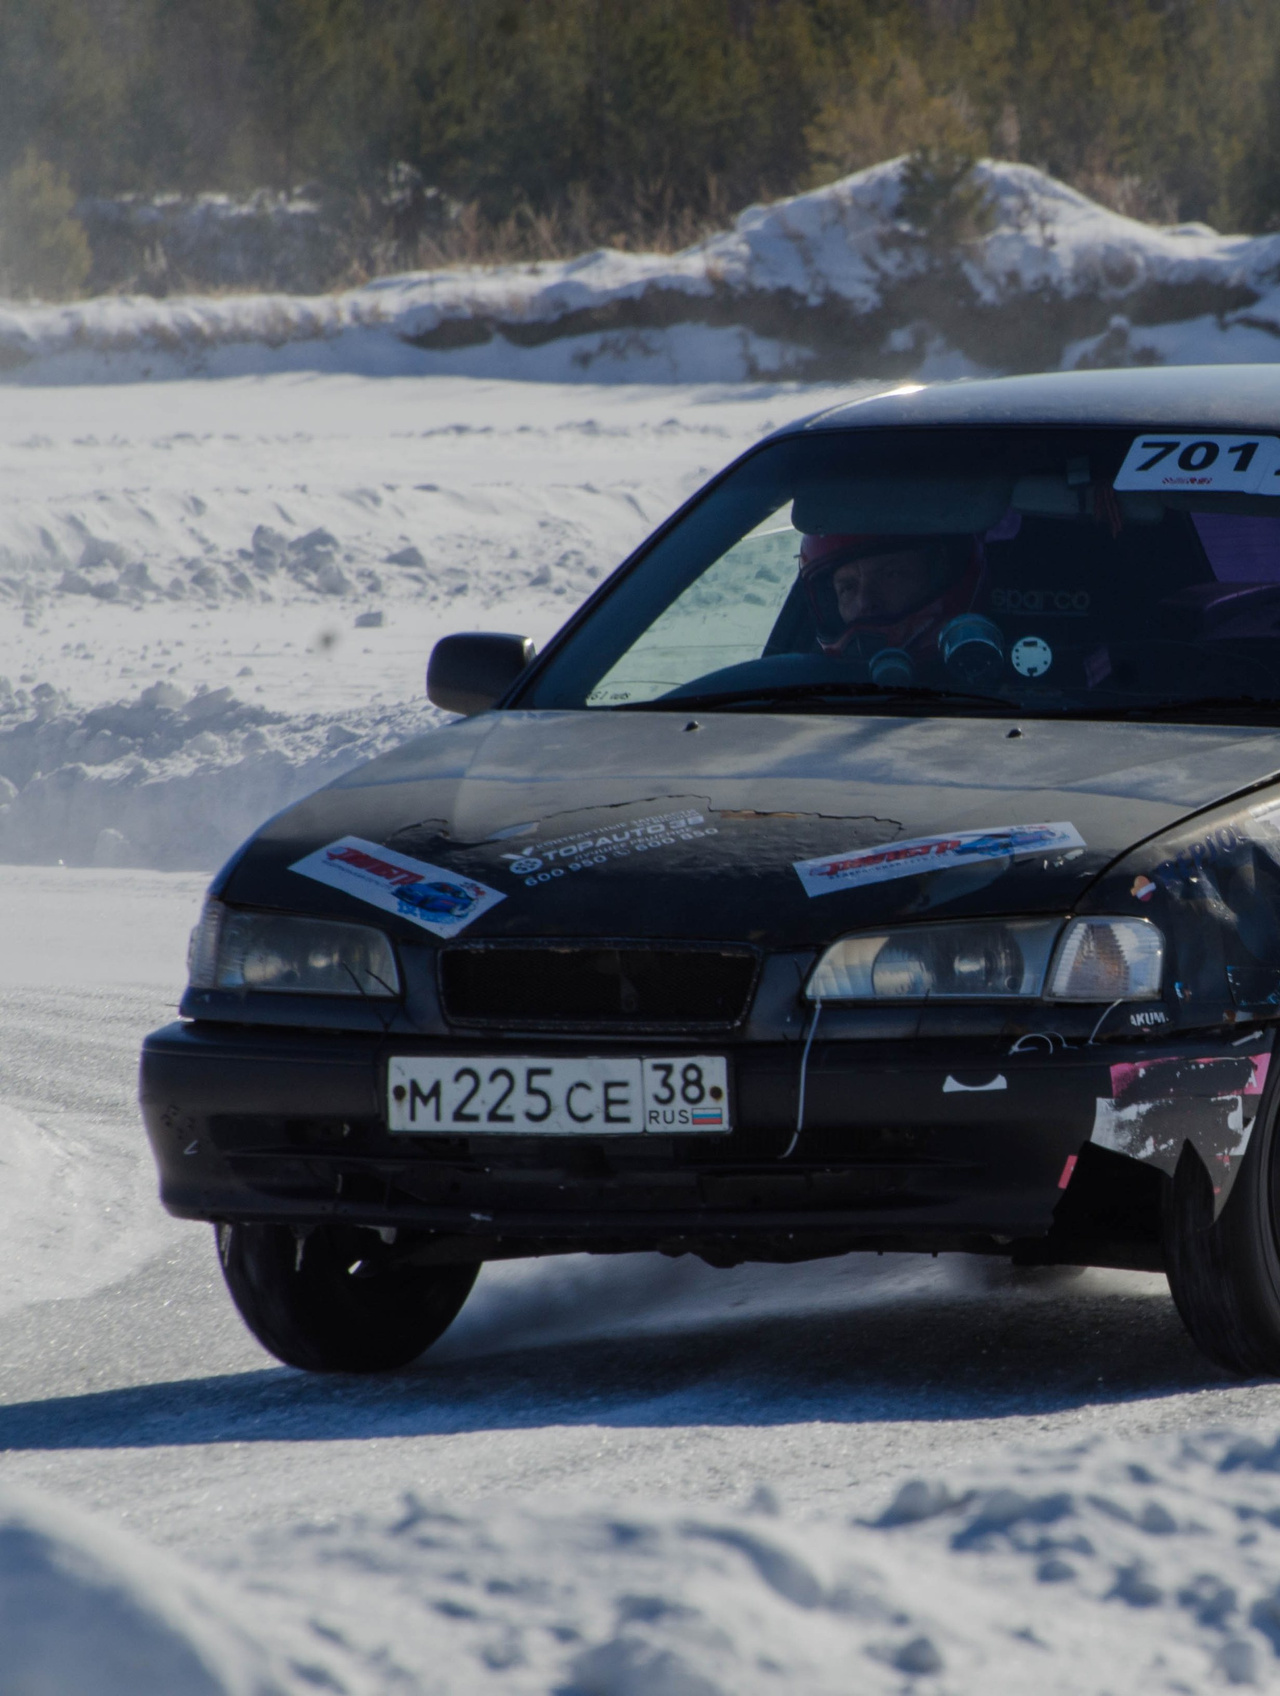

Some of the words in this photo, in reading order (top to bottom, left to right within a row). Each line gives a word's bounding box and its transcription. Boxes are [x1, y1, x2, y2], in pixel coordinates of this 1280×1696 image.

[1135, 441, 1260, 472] 701
[542, 824, 665, 861] TOPAUTO
[524, 868, 564, 887] 600
[651, 1063, 705, 1105] 38
[648, 1110, 690, 1124] RUS
